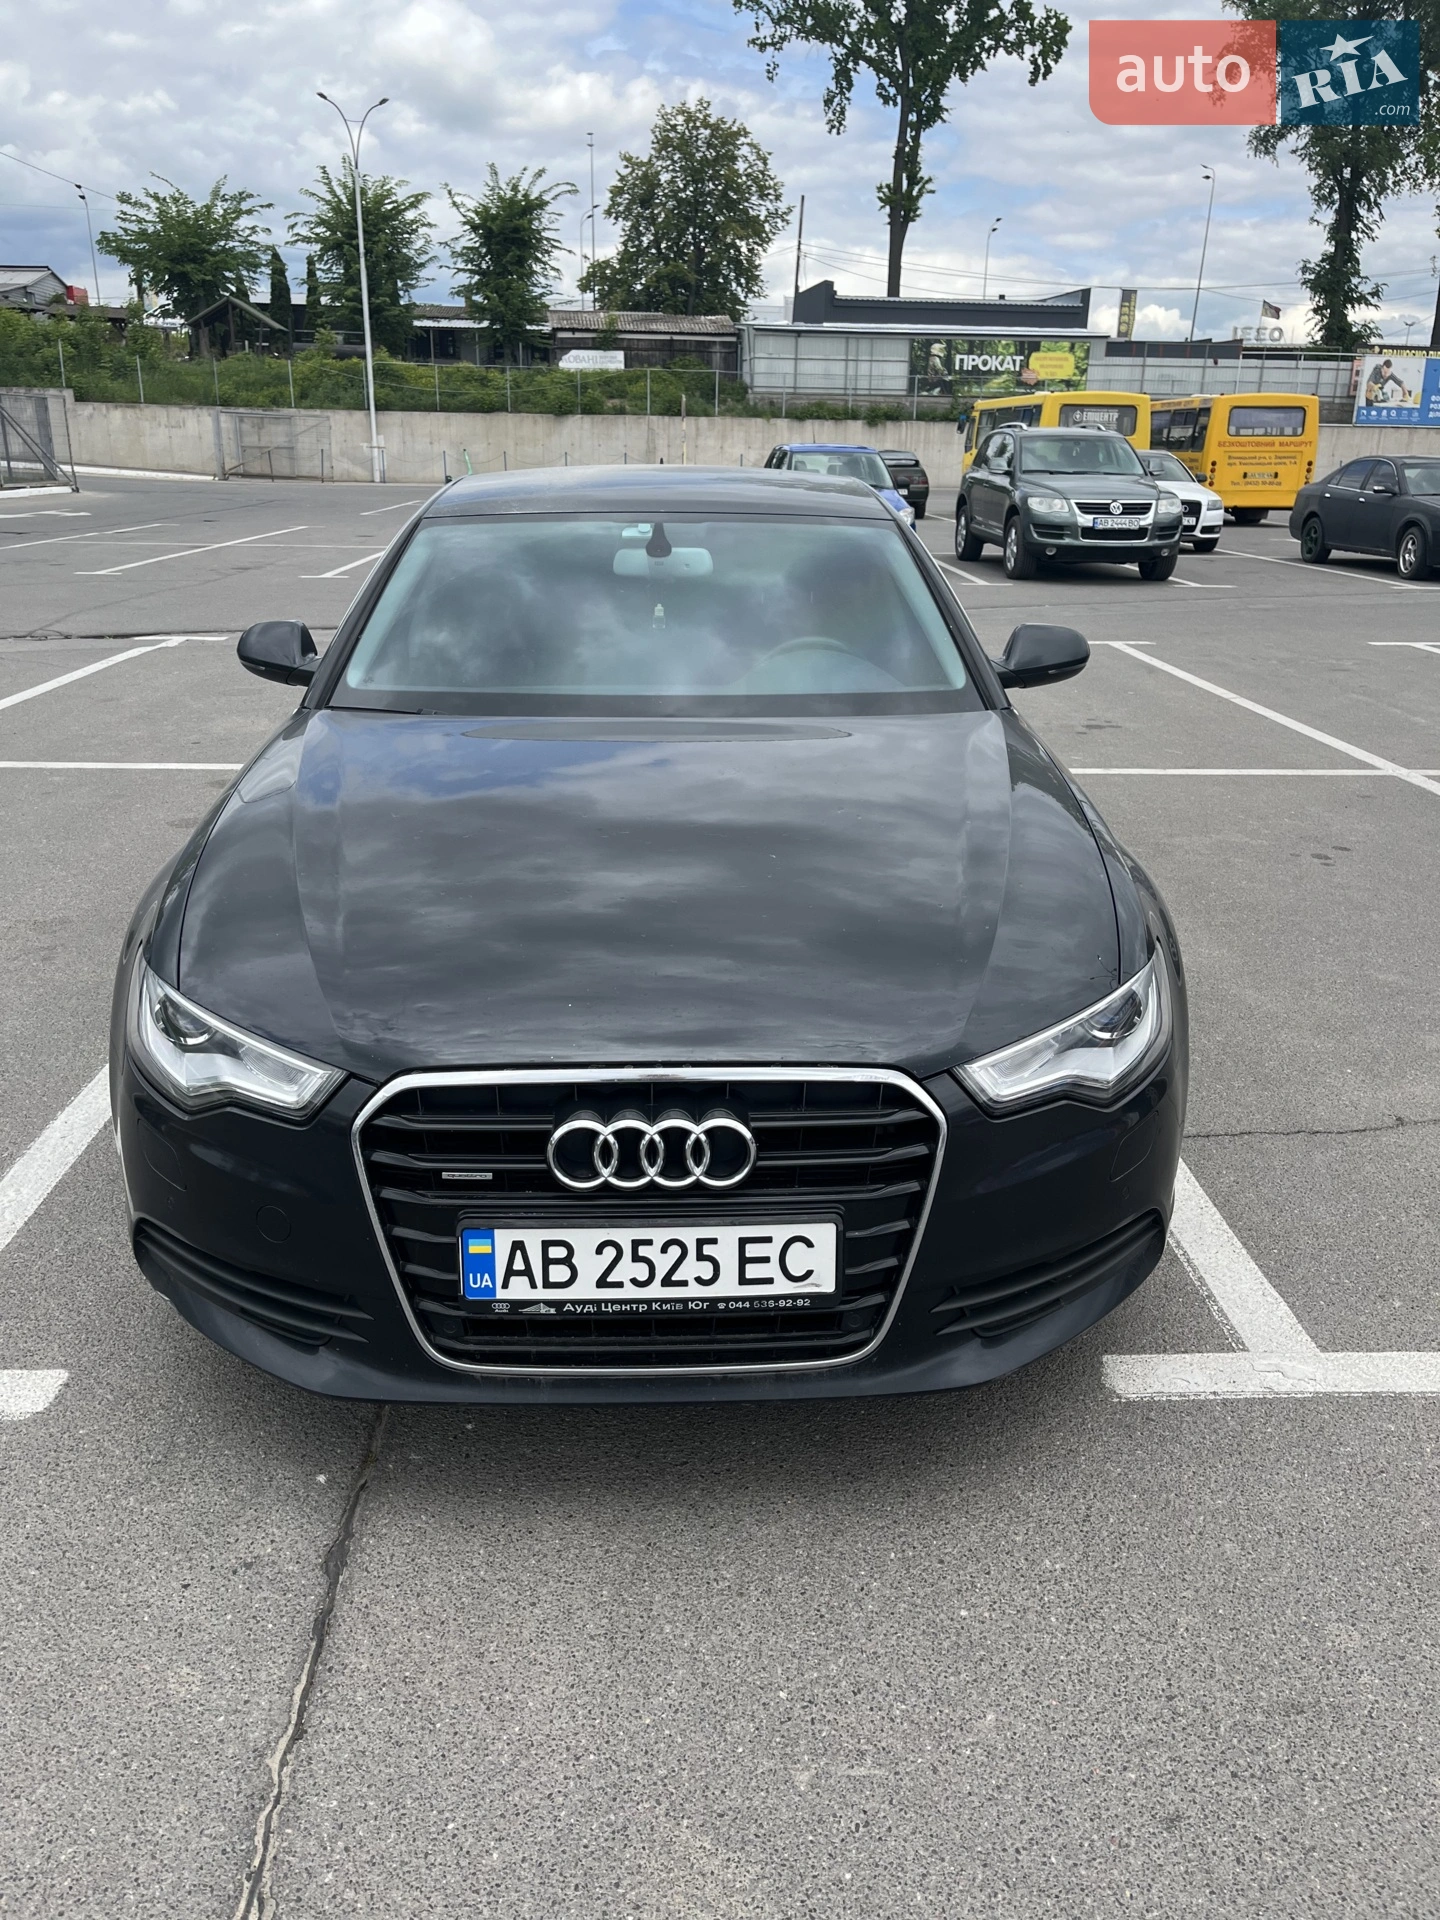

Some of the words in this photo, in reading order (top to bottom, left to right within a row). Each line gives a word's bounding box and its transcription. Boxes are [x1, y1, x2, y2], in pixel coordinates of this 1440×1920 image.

[955, 354, 1024, 372] ПРОКАТ
[1217, 440, 1276, 448] БЕЗКОШТОВНИЙ
[1099, 519, 1109, 527] AB
[1110, 519, 1128, 527] 2444
[501, 1239, 579, 1289] AB
[595, 1237, 721, 1289] 2525
[738, 1235, 815, 1286] EC
[469, 1273, 493, 1288] UA
[562, 1302, 598, 1313] Ауді
[601, 1302, 648, 1313] Центр
[652, 1301, 684, 1311] Київ
[688, 1301, 710, 1310] Юг
[728, 1300, 751, 1309] 044
